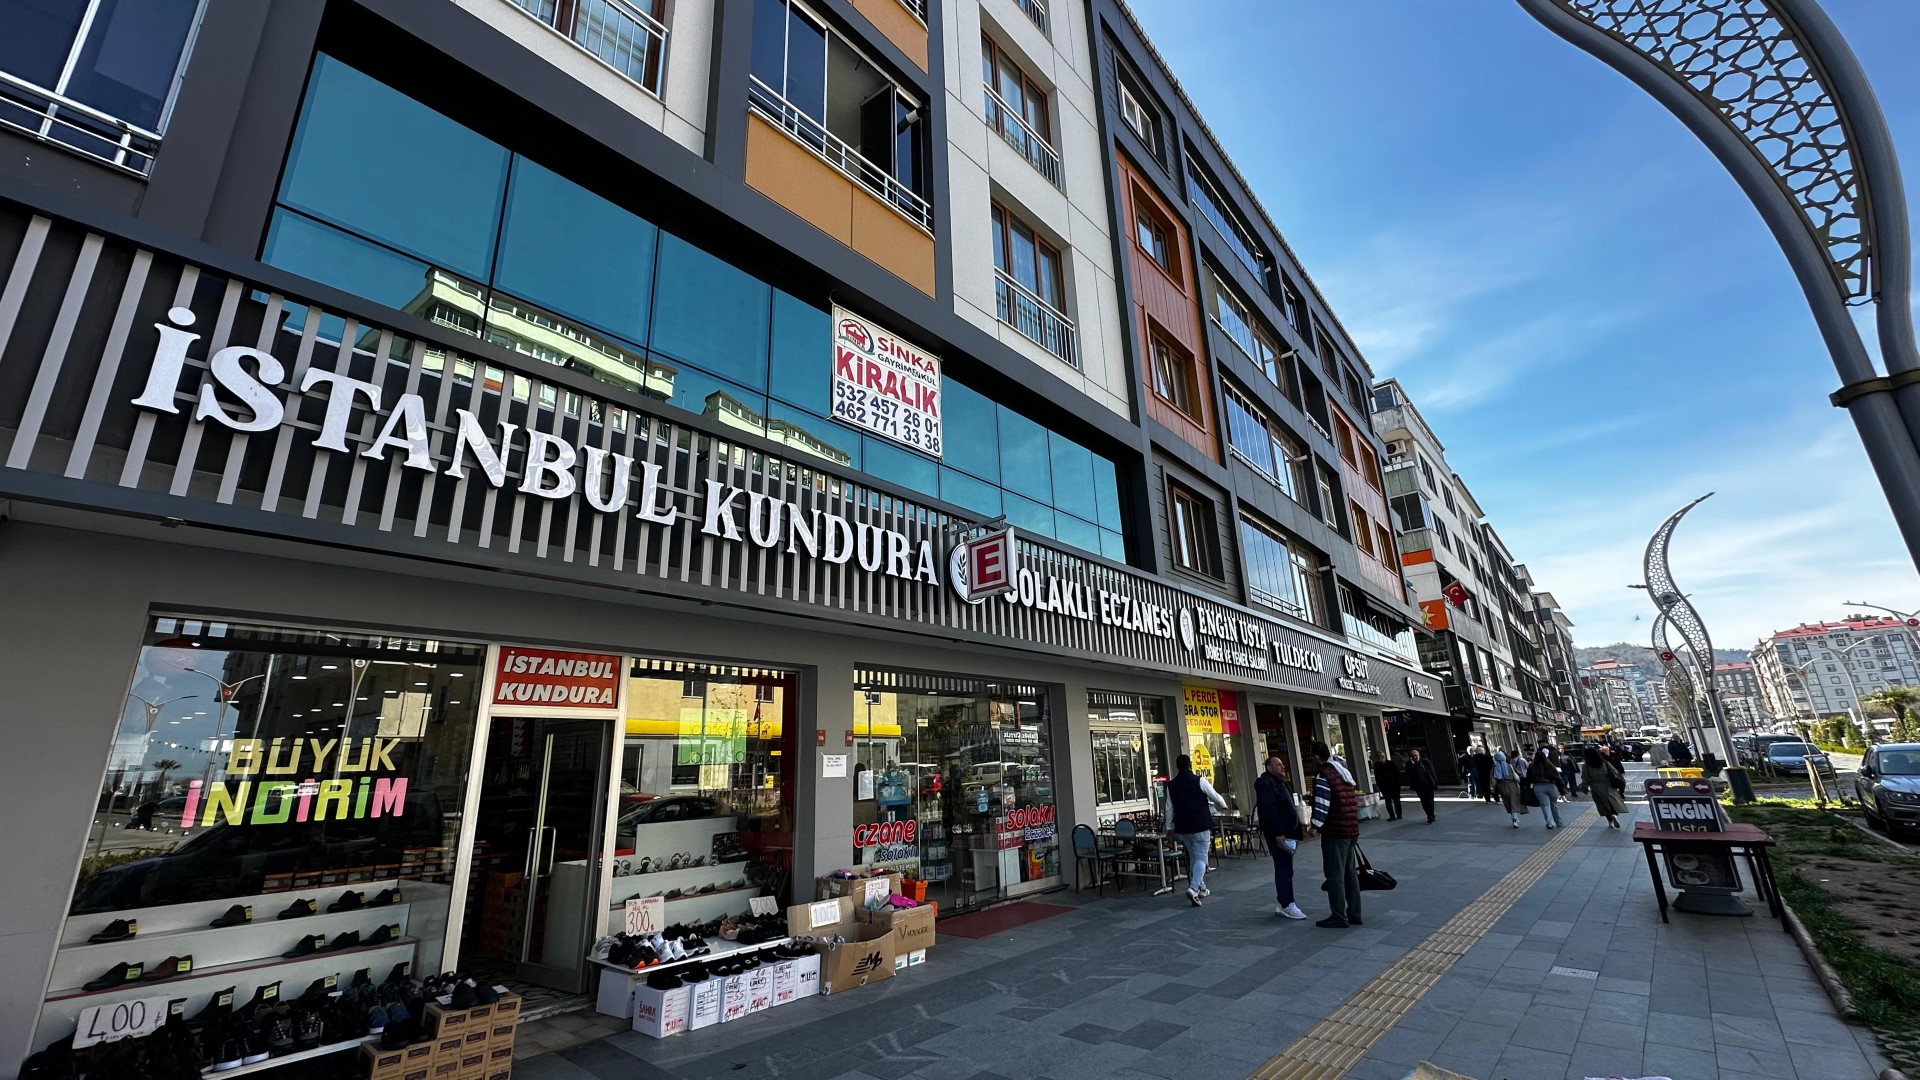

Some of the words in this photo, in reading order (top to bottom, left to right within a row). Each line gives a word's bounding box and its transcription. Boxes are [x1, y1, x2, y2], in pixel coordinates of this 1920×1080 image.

[877, 336, 936, 376] SİNKA
[877, 353, 937, 387] GAYRİMENKUL
[836, 345, 939, 418] KİRALIK
[835, 400, 867, 424] 462
[871, 411, 898, 437] 771
[903, 425, 920, 445] 33
[924, 434, 940, 453] 38
[836, 380, 867, 407] 532
[870, 396, 899, 418] 457
[903, 408, 921, 429] 26
[924, 417, 939, 437] 01
[131, 306, 677, 527] İSTANBUL
[701, 478, 940, 587] KUNDURA
[977, 543, 1001, 585] E
[1099, 590, 1175, 640] ECZANESİ
[1197, 606, 1238, 643] ENGİN
[1239, 619, 1268, 651] USTA
[503, 650, 613, 679] İSTANBUL
[497, 682, 613, 705] KUNDURA
[1191, 690, 1217, 704] PERDE
[1200, 705, 1219, 718] STOR
[226, 737, 401, 775] BÜYÜK
[180, 777, 409, 828] İNDİRİM
[1658, 799, 1714, 820] ENGİN
[628, 910, 650, 934] 300
